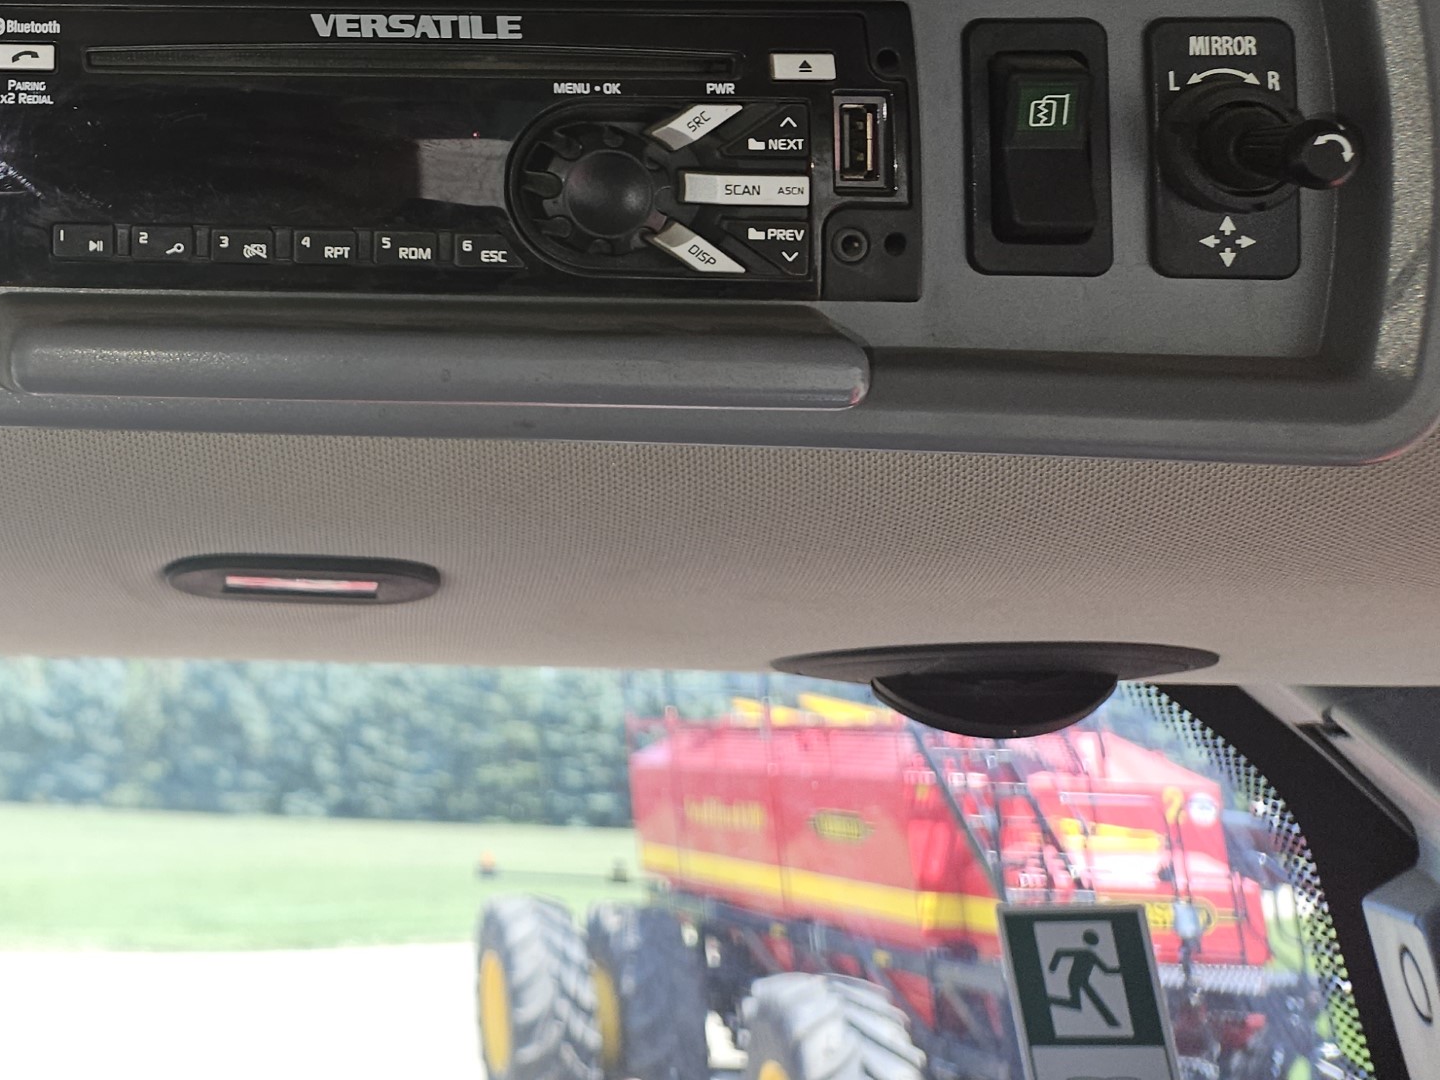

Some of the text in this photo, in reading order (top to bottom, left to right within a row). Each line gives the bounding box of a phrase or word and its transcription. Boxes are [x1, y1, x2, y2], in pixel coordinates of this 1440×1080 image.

[6, 19, 61, 34] Bluetooth
[310, 13, 523, 39] VERSATILE
[1188, 35, 1257, 57] MIRROR
[1167, 70, 1180, 92] L
[1266, 69, 1281, 91] R
[552, 81, 622, 95] MENU OK
[706, 82, 735, 95] PWR
[686, 110, 712, 133] SRC
[768, 137, 804, 152] NEXT
[724, 183, 805, 198] SCAN ASCN
[138, 231, 149, 244] 2
[219, 235, 229, 248] 3
[381, 236, 392, 249] 5
[767, 228, 805, 242] PREV
[300, 236, 351, 259] 4 RPT
[462, 239, 508, 263] 6 ESC
[687, 243, 717, 267] DISP
